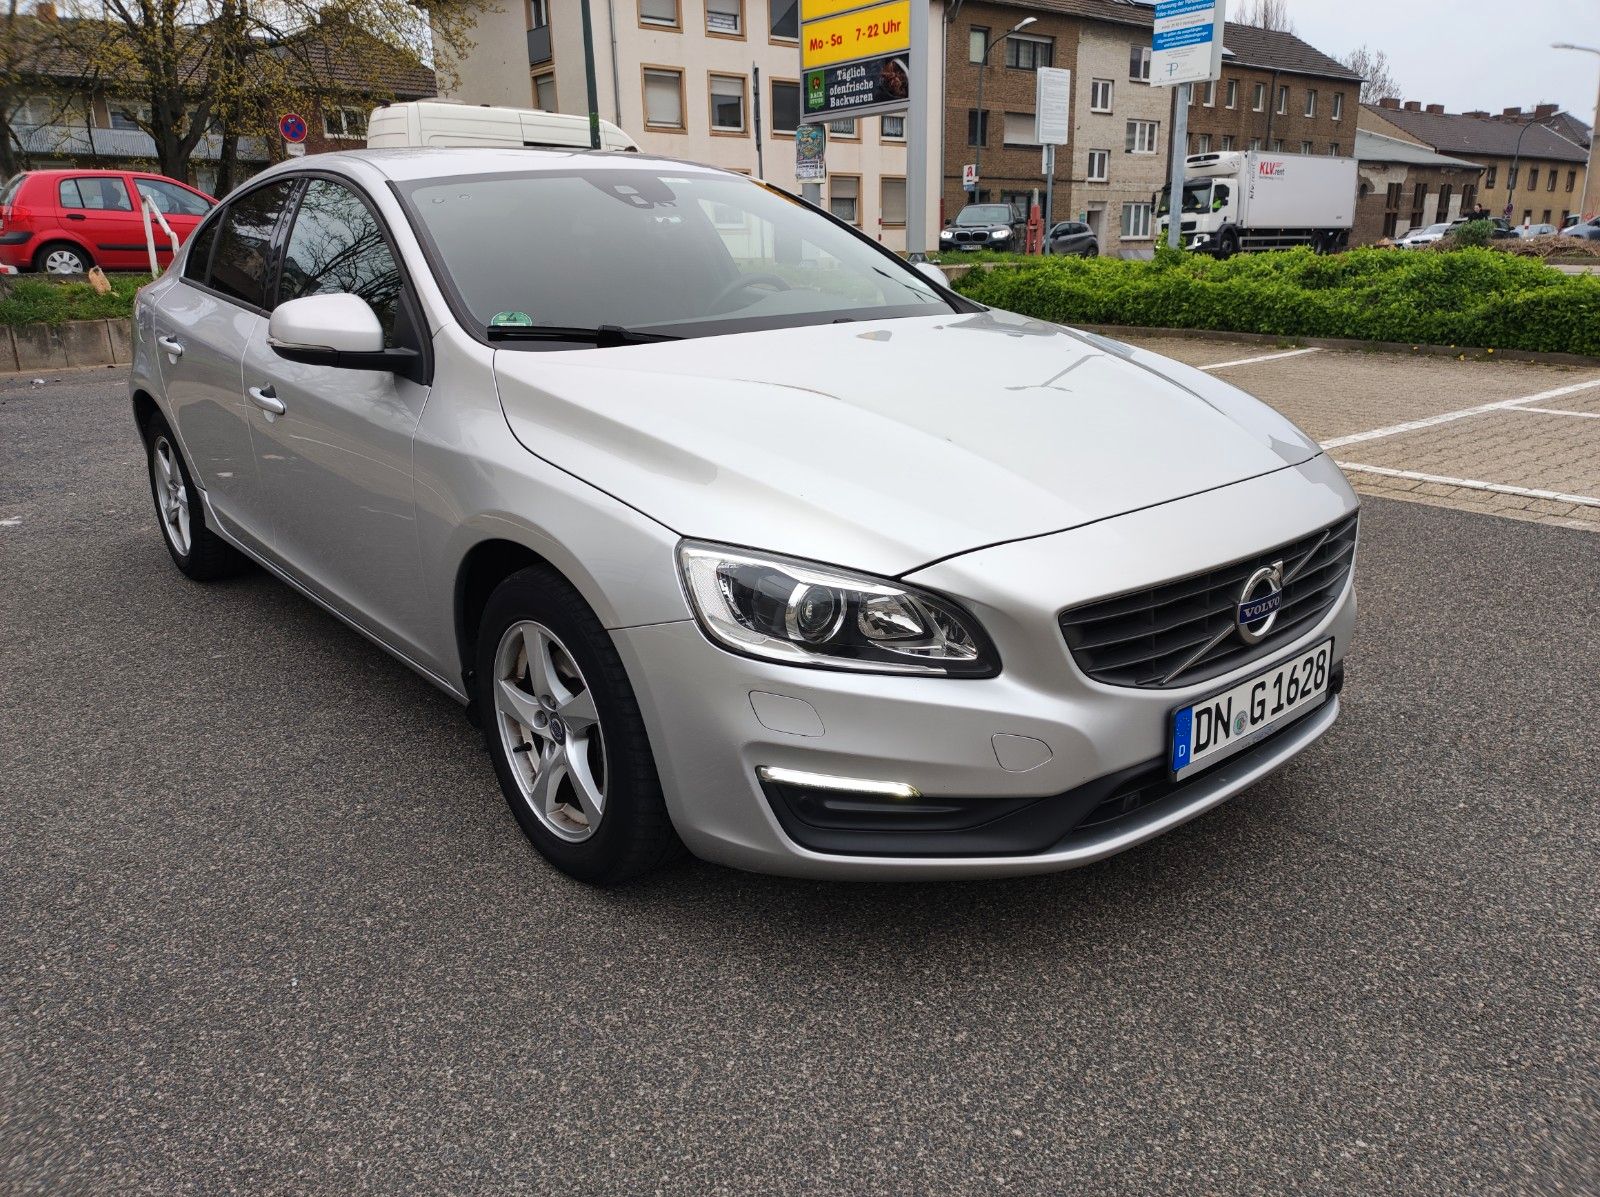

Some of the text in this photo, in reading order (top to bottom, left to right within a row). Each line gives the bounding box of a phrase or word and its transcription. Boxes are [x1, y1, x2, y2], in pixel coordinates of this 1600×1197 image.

[809, 38, 824, 51] Mo
[831, 34, 843, 47] Sa
[883, 19, 902, 35] Uhr
[837, 66, 866, 82] Täglich
[829, 79, 874, 96] ofenfrische
[830, 93, 874, 108] Backwaren
[1243, 596, 1280, 618] VOLVO
[1194, 696, 1232, 754] DN
[1178, 744, 1186, 758] D
